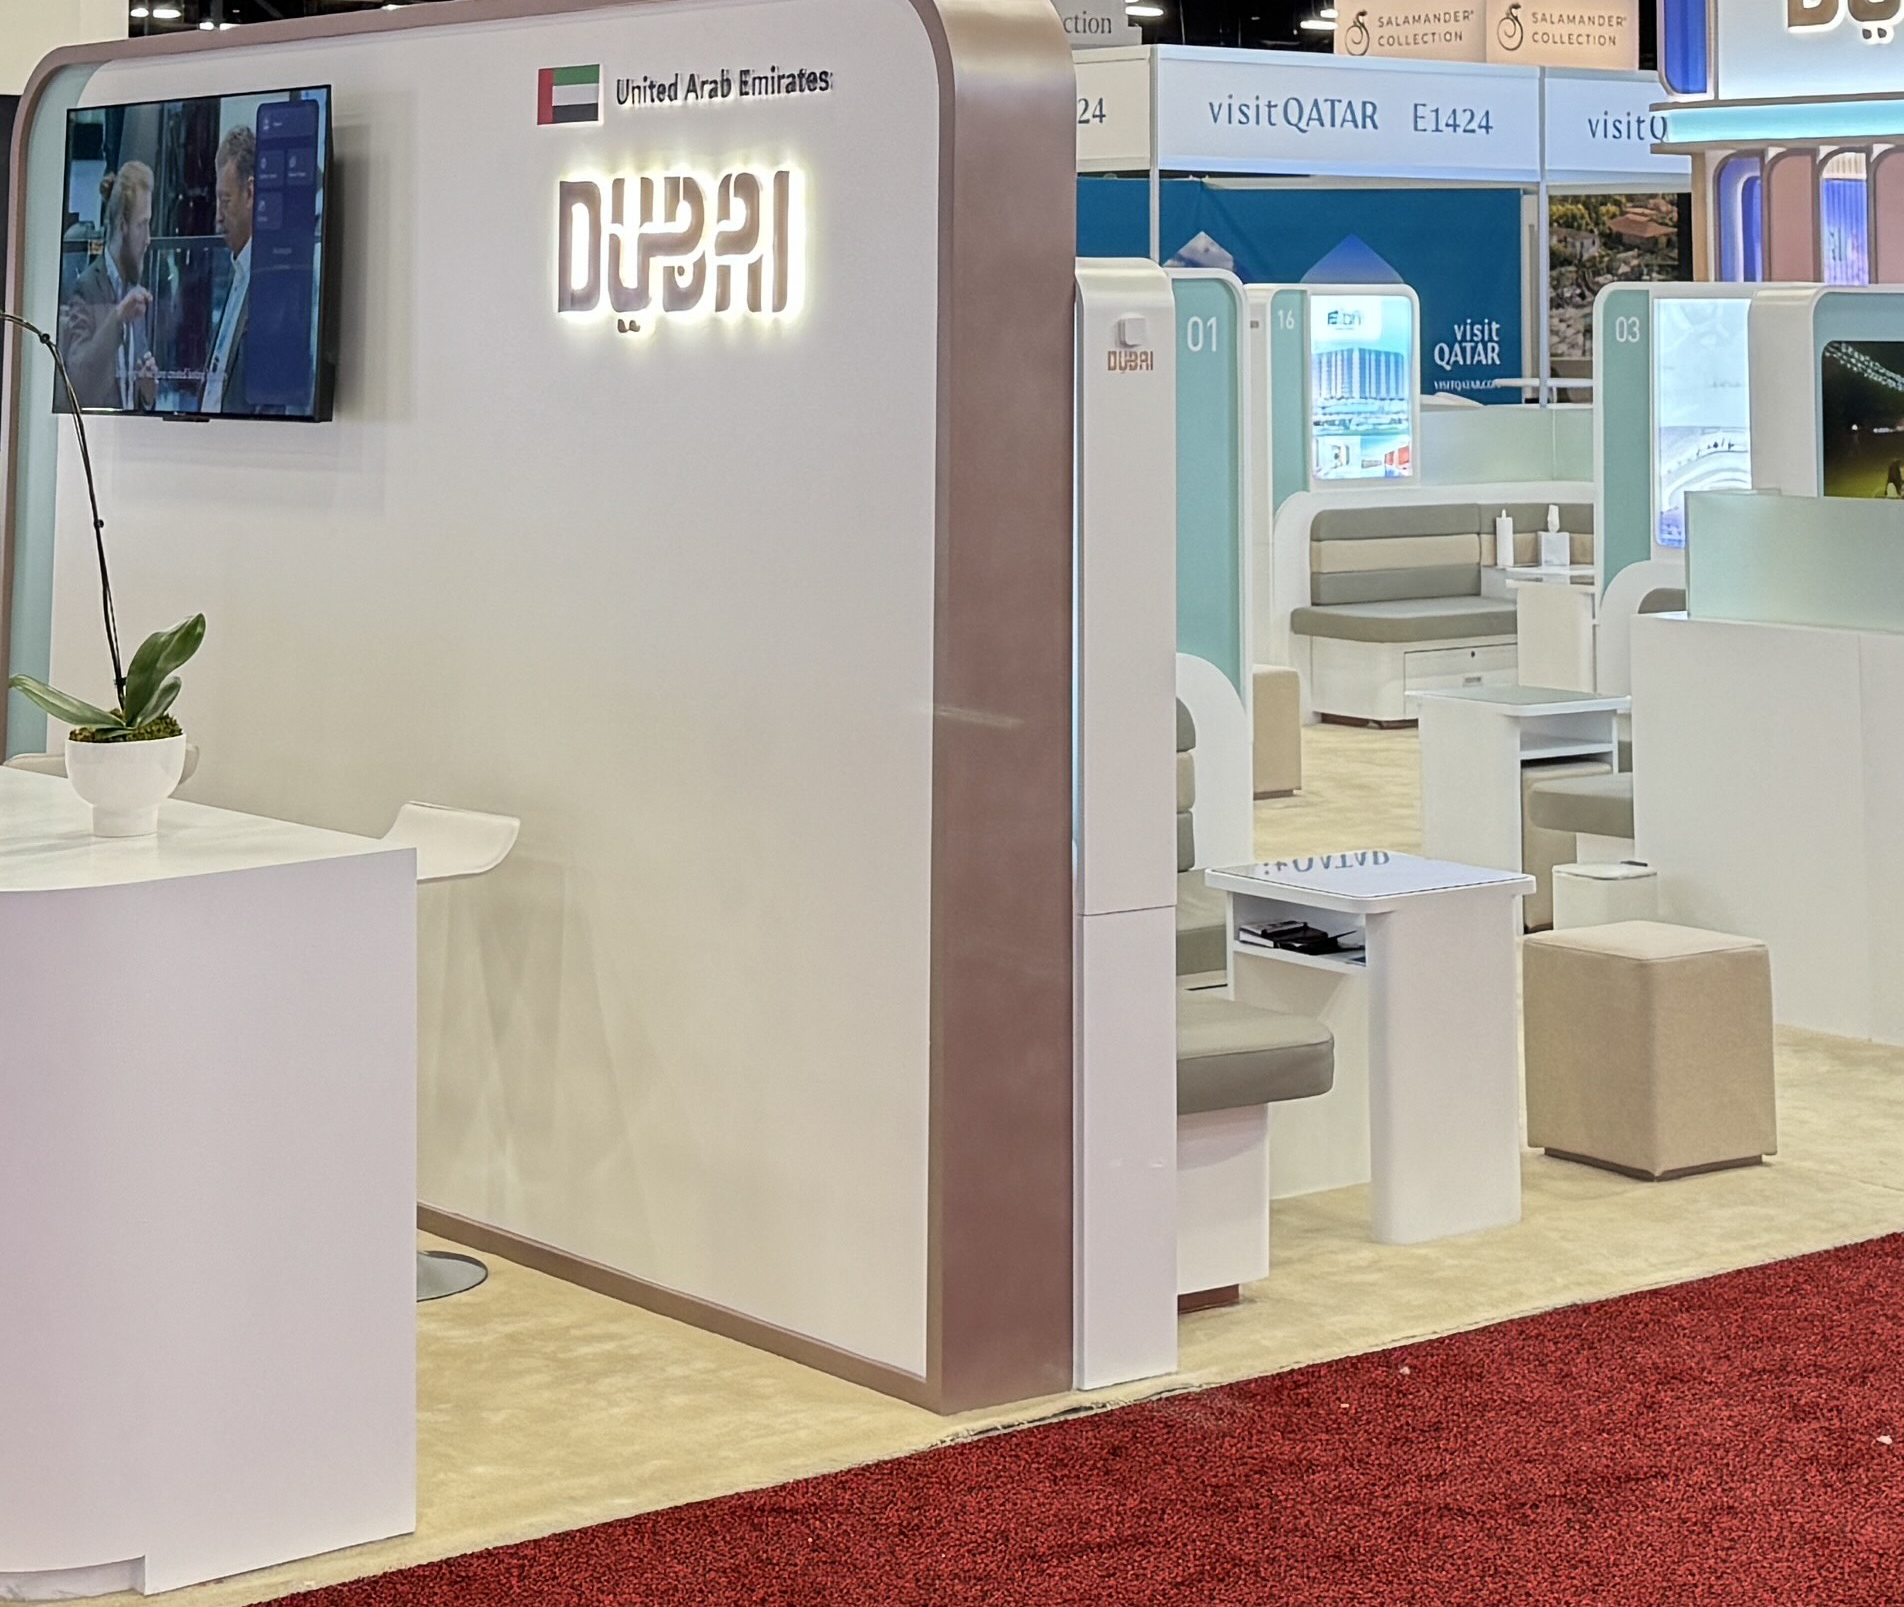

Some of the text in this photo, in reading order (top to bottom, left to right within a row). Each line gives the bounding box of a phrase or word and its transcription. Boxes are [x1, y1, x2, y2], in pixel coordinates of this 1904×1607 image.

[1378, 31, 1464, 48] COLLECTION
[1532, 32, 1617, 47] COLLECTION
[616, 65, 832, 106] United Arab Emirates
[1413, 102, 1494, 136] E1424
[1187, 315, 1217, 352] 01
[1277, 310, 1294, 330] 16
[1454, 318, 1501, 342] visit
[1615, 316, 1640, 343] 03
[1434, 342, 1501, 371] QATAR
